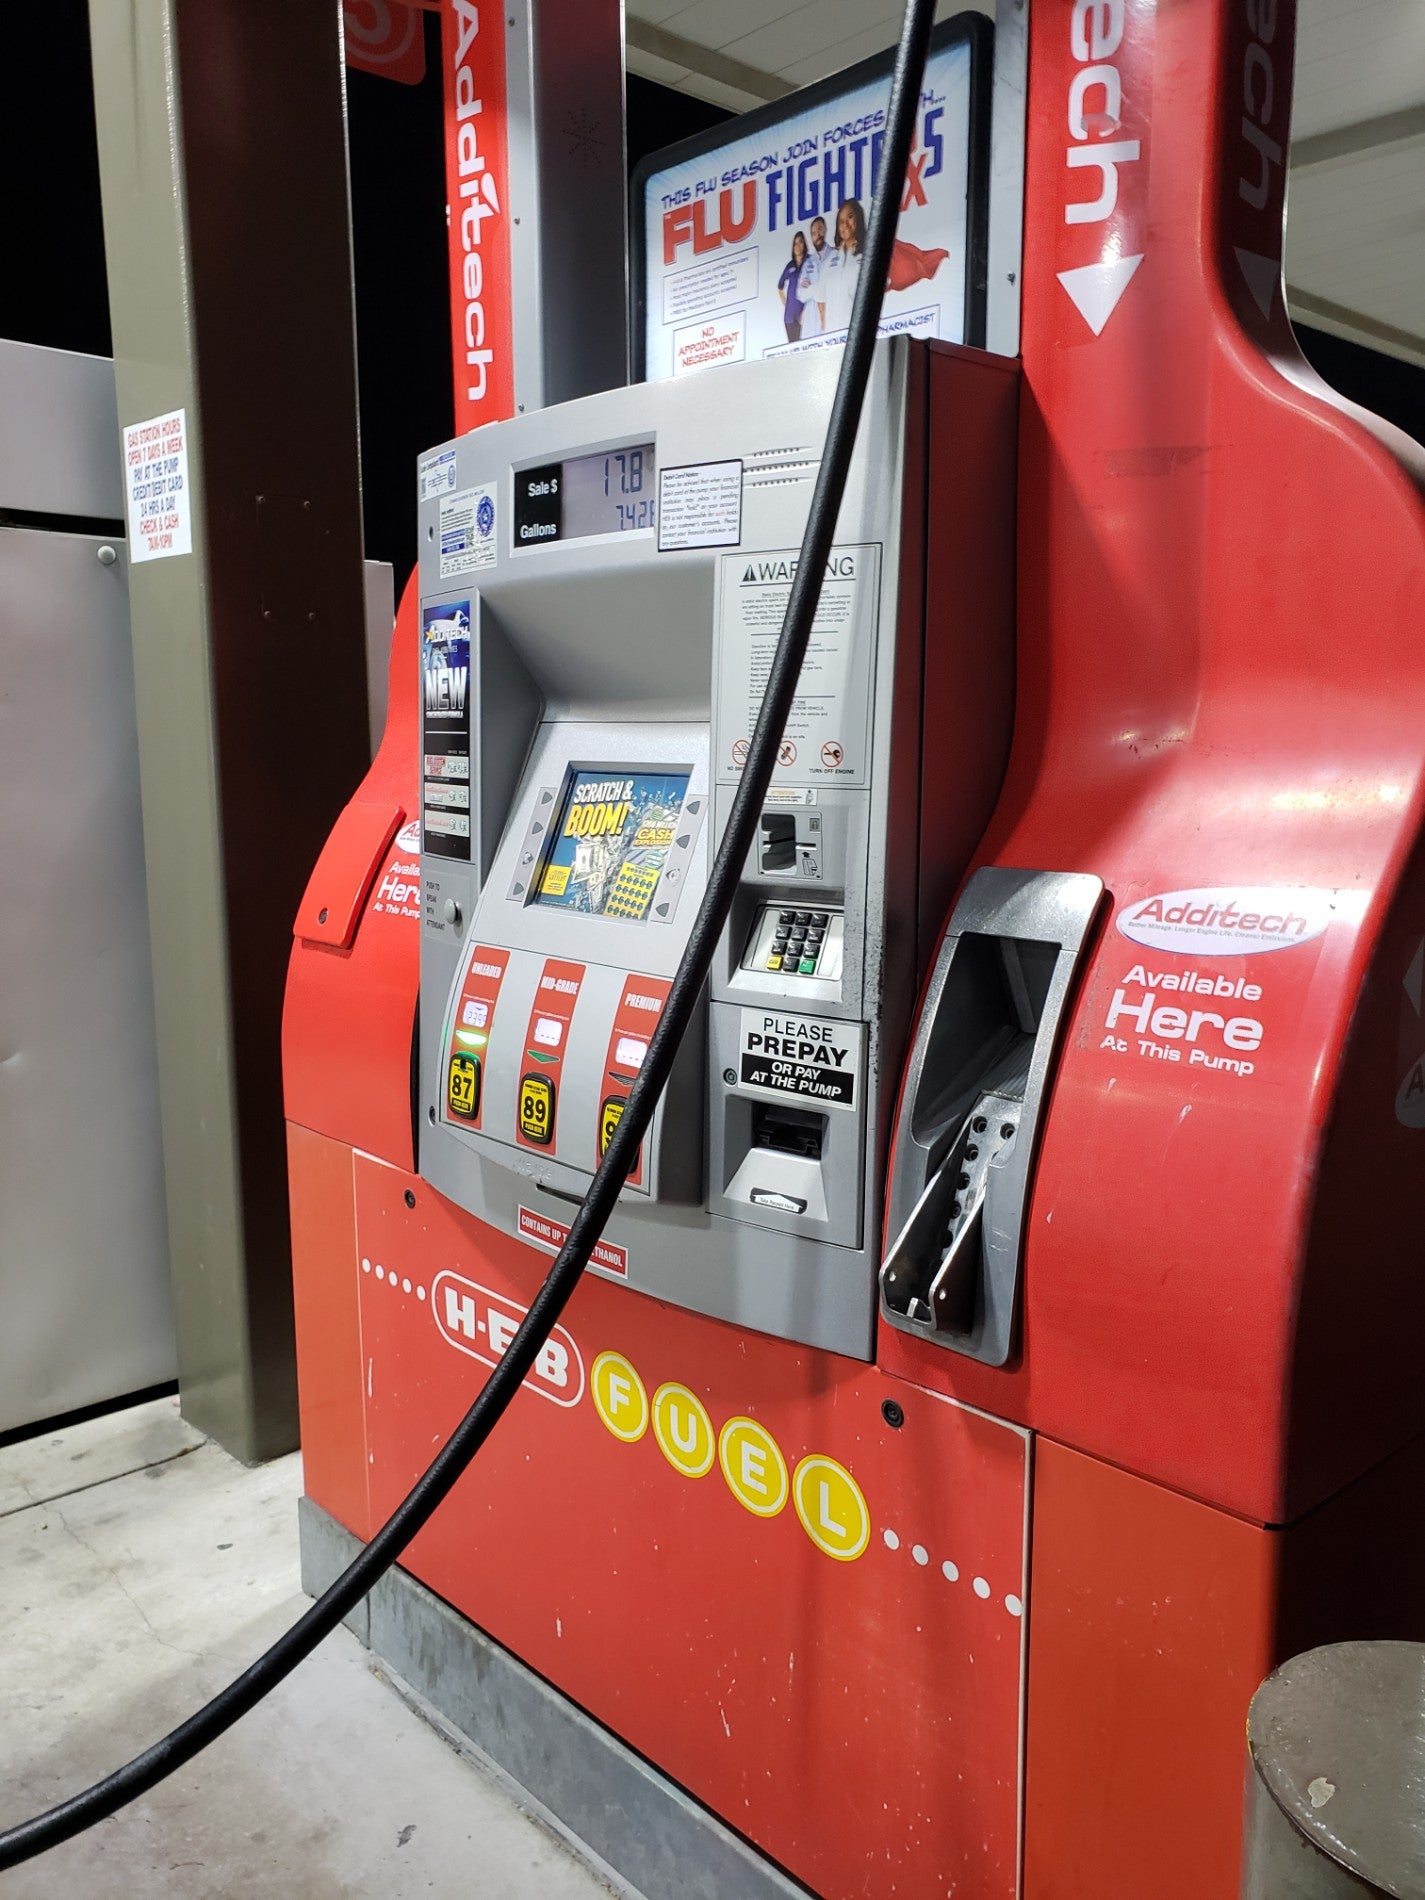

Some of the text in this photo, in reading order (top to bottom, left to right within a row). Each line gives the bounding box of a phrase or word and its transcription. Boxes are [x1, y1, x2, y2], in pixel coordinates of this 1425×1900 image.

[661, 187, 691, 209] THIS
[696, 176, 717, 197] FLU
[722, 152, 779, 187] SEASON
[783, 135, 818, 163] JOIN
[824, 110, 885, 147] FORCES
[451, 0, 501, 401] Additech
[663, 180, 757, 265] FLU
[678, 332, 740, 357] APPOINTMENT
[702, 326, 715, 338] NO
[682, 345, 735, 367] NECESSARY
[528, 479, 558, 497] Sale $
[520, 524, 557, 539] Gallons
[758, 556, 855, 582] WARNG
[426, 666, 467, 710] NEW
[574, 780, 634, 803] SCRATCH &
[564, 801, 629, 837] BOOM!
[638, 827, 675, 840] CASH
[386, 904, 400, 915] This
[1132, 899, 1307, 936] Additech
[1128, 921, 1147, 929] Better
[472, 962, 502, 979] UNLEADED
[1122, 965, 1262, 1001] Available
[540, 976, 580, 995] MID-GRADE
[625, 993, 663, 1013] PREMIUM
[764, 1017, 833, 1043] PLEASE
[1105, 988, 1263, 1051] Here
[748, 1032, 848, 1067] PREPAY
[1100, 1035, 1254, 1077] At This Pump
[750, 1070, 842, 1098] AT THE PUMP
[772, 1062, 821, 1081] OR PAY
[452, 1074, 472, 1099] 87
[524, 1096, 546, 1123] 89
[522, 1214, 551, 1237] CONTAINS
[552, 1228, 562, 1241] UP
